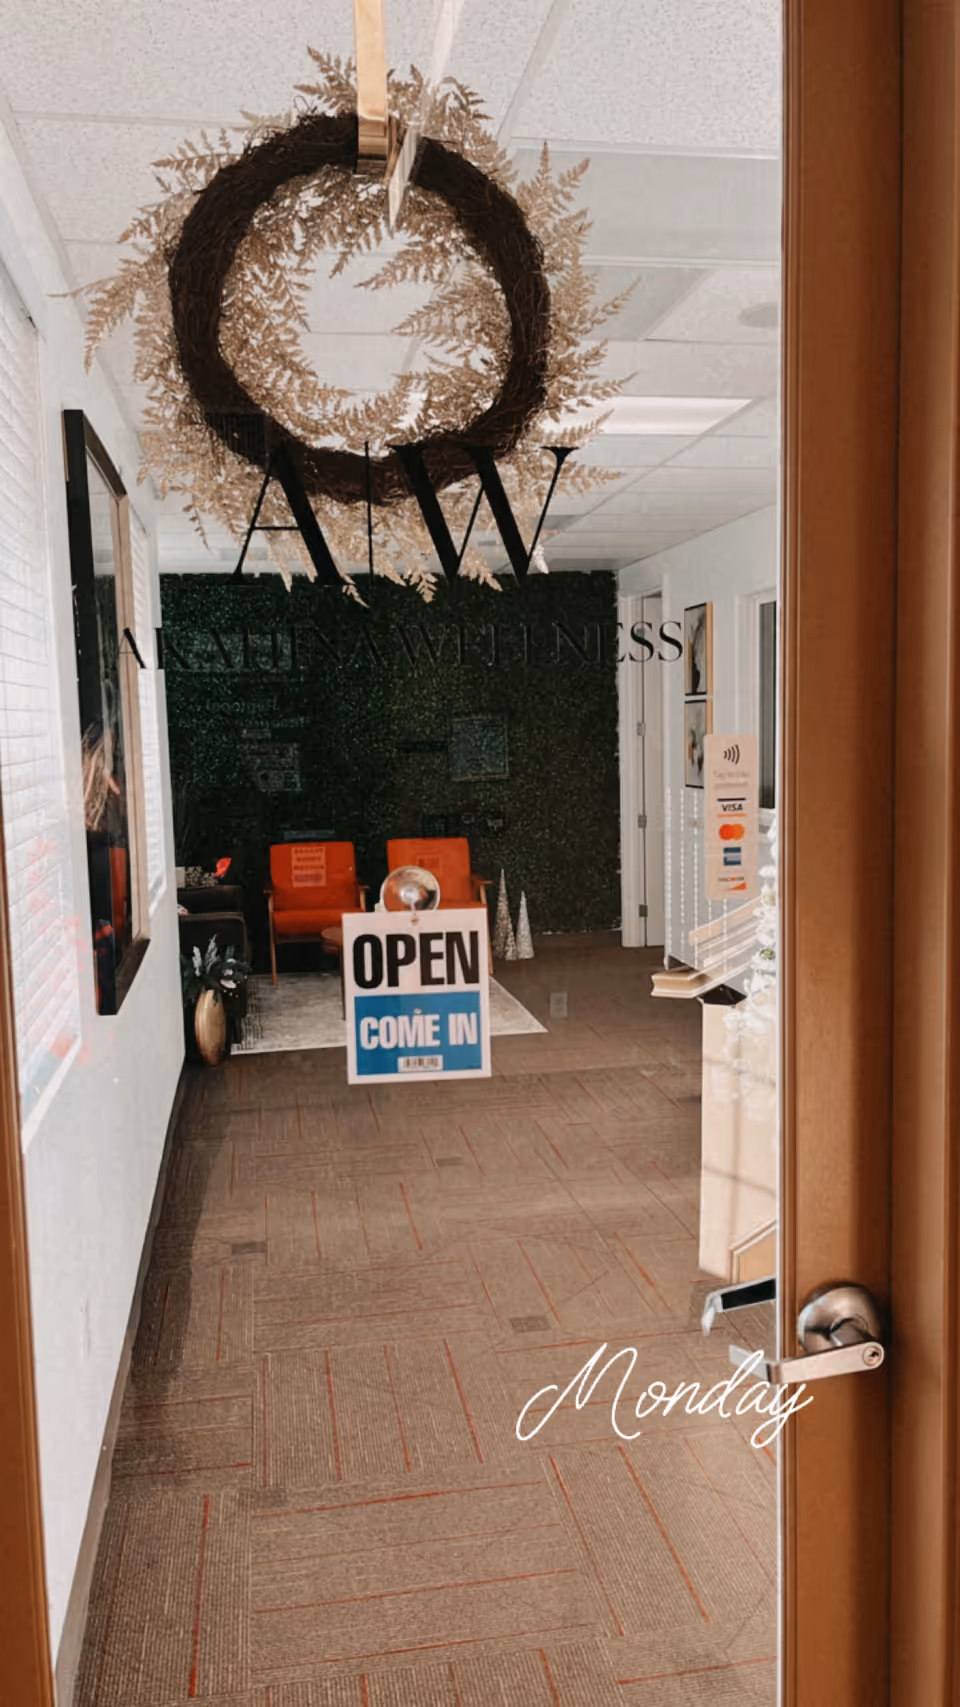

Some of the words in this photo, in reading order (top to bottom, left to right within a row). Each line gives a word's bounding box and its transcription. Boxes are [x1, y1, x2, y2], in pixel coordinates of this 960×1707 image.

[721, 803, 743, 812] VISA
[353, 931, 480, 989] OPEN
[360, 1013, 441, 1050] COME
[448, 1012, 478, 1045] IN
